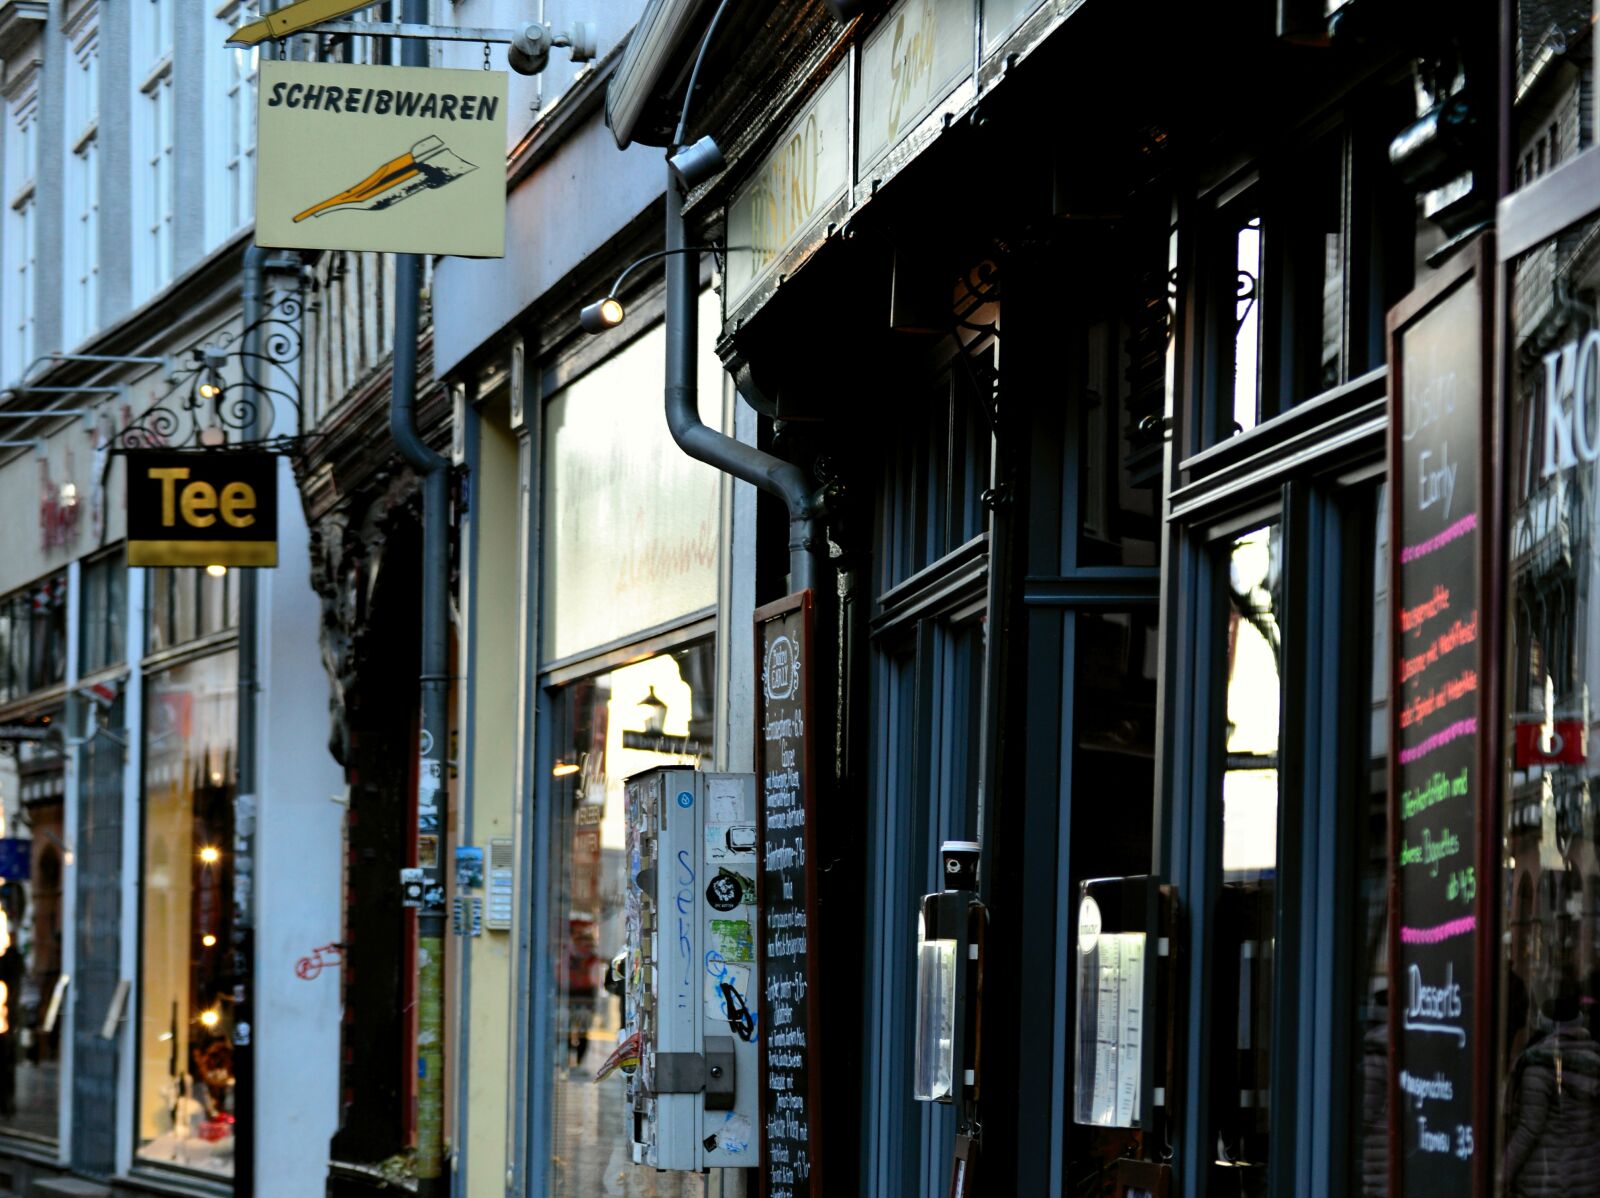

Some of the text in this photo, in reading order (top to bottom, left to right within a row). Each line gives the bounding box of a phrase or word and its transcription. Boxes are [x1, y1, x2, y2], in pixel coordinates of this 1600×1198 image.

[267, 80, 500, 122] SCHREIBWAREN
[751, 111, 818, 281] BISTRO
[147, 466, 257, 529] Tee
[1417, 440, 1458, 521] Early
[1407, 962, 1462, 1020] Desserts
